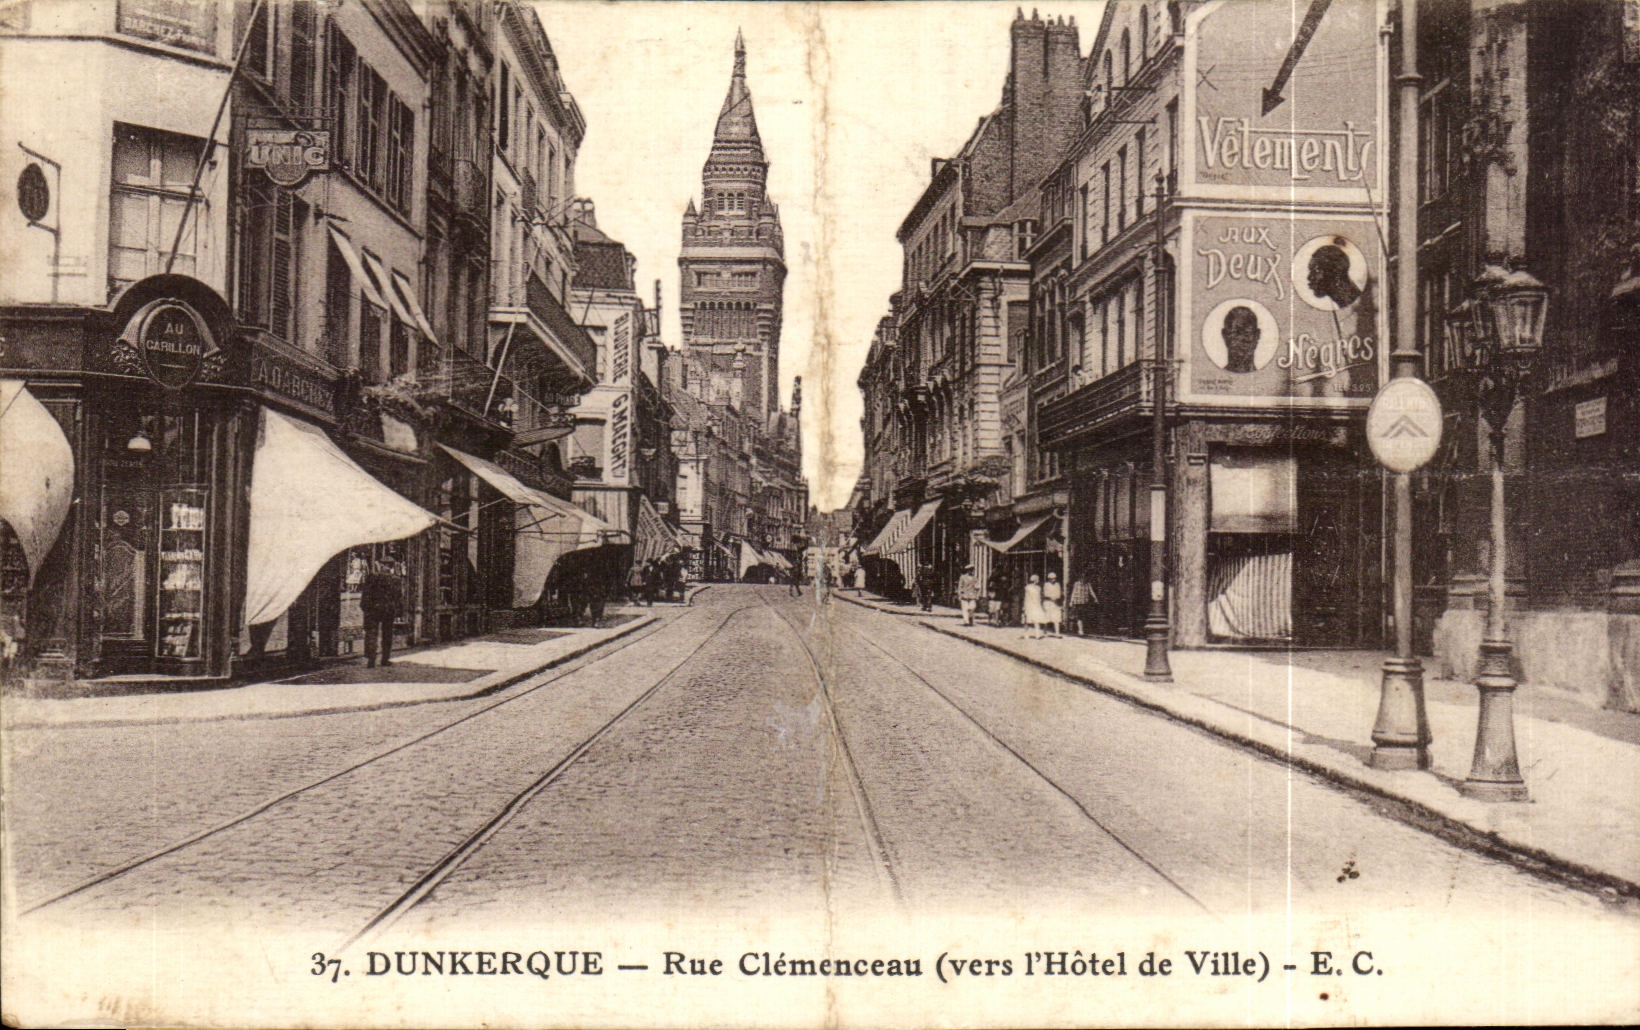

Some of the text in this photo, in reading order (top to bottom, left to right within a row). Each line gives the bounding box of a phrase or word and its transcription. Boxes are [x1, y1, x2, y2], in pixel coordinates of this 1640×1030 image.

[250, 145, 325, 166] UNIC
[1198, 117, 1375, 182] Vêtements
[1197, 248, 1285, 301] Deux
[164, 322, 184, 335] AU
[145, 340, 200, 356] CARILLON
[1277, 333, 1374, 379] Nègres
